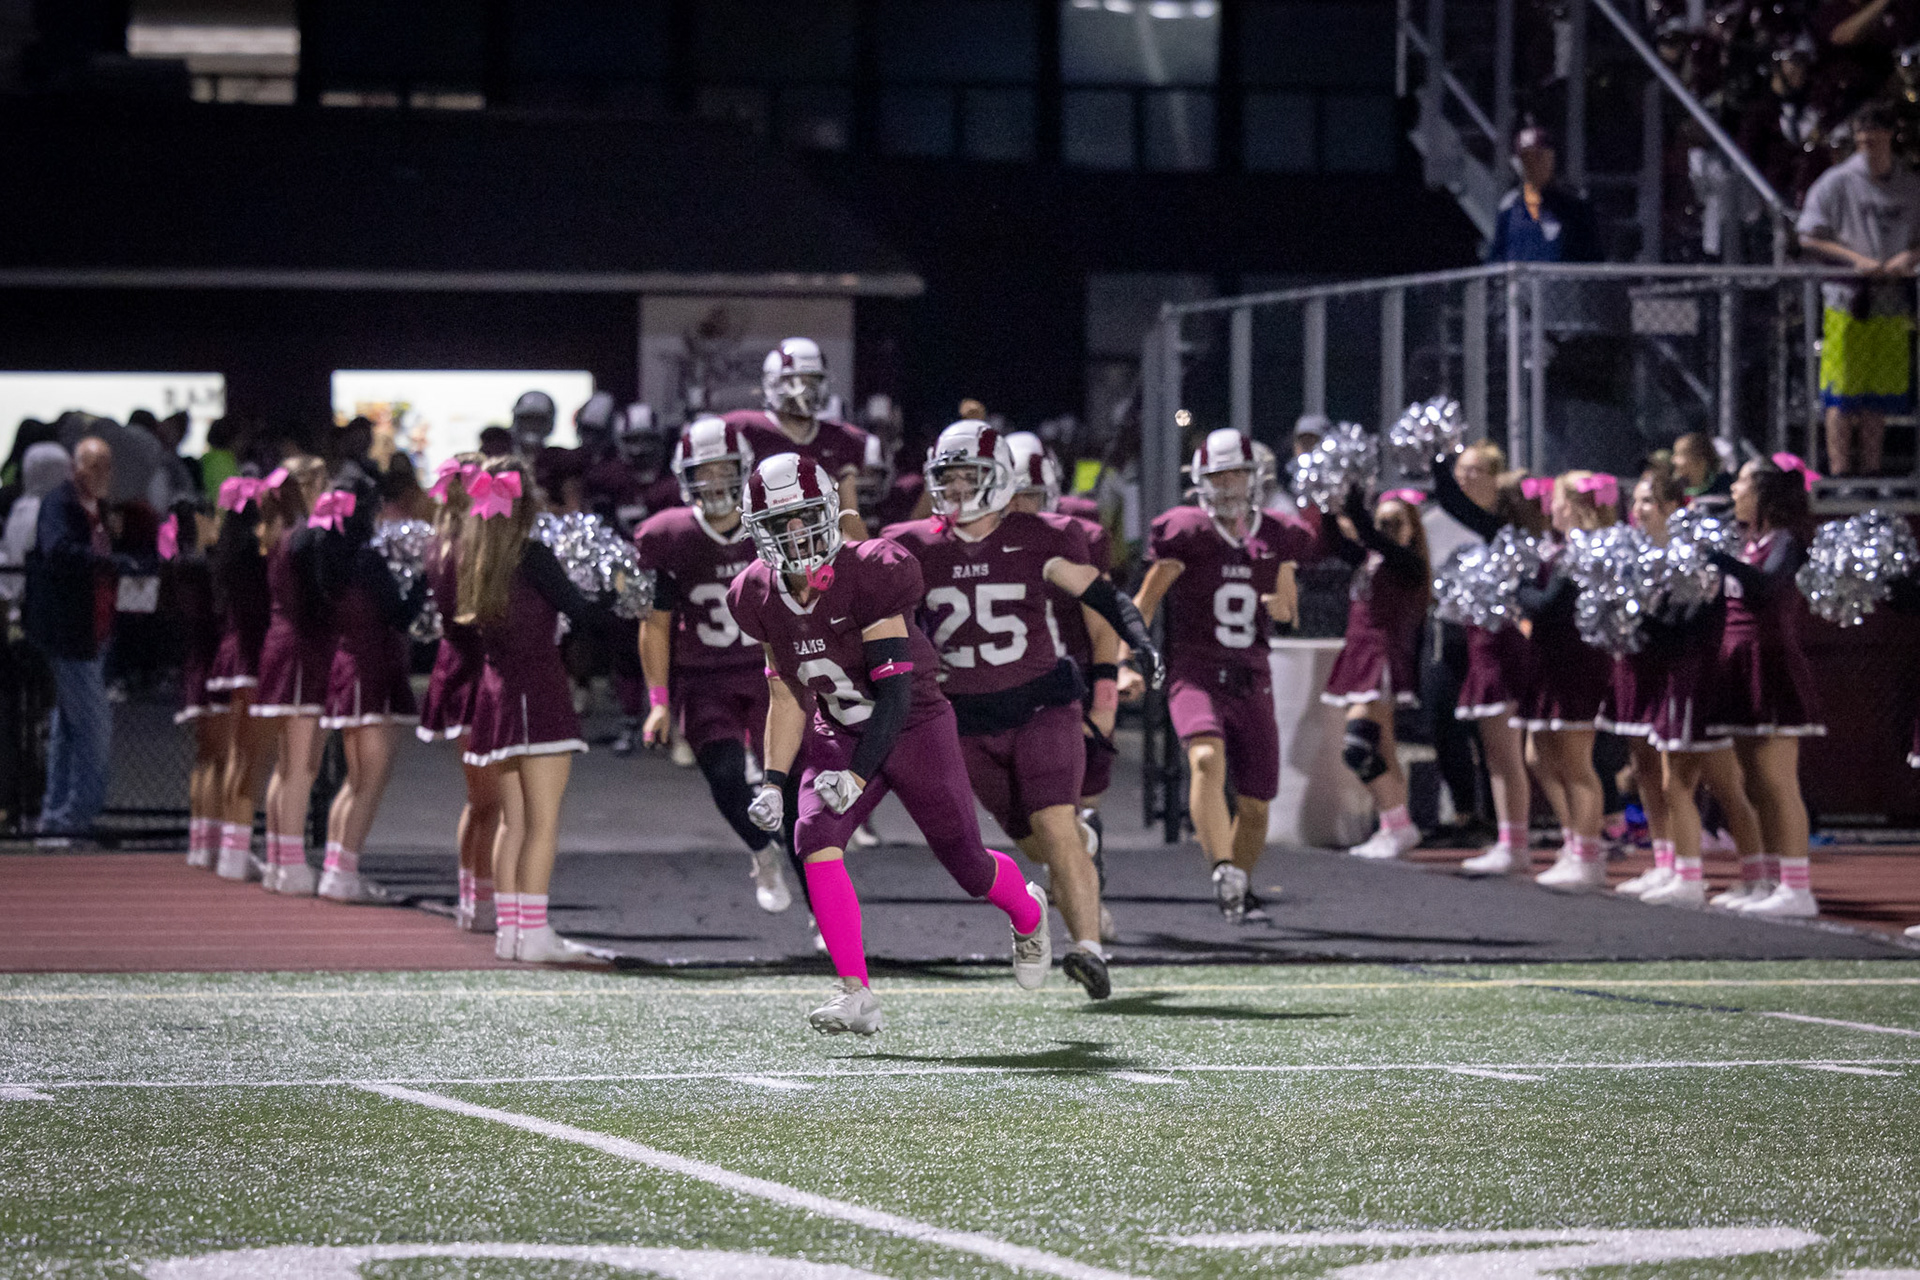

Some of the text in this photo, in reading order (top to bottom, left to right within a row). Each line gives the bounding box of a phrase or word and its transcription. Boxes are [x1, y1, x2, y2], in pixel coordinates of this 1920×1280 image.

[952, 562, 990, 579] RAMS
[689, 582, 759, 648] 3
[793, 638, 826, 655] RAMS
[925, 583, 1029, 668] 25
[1213, 582, 1258, 649] 9
